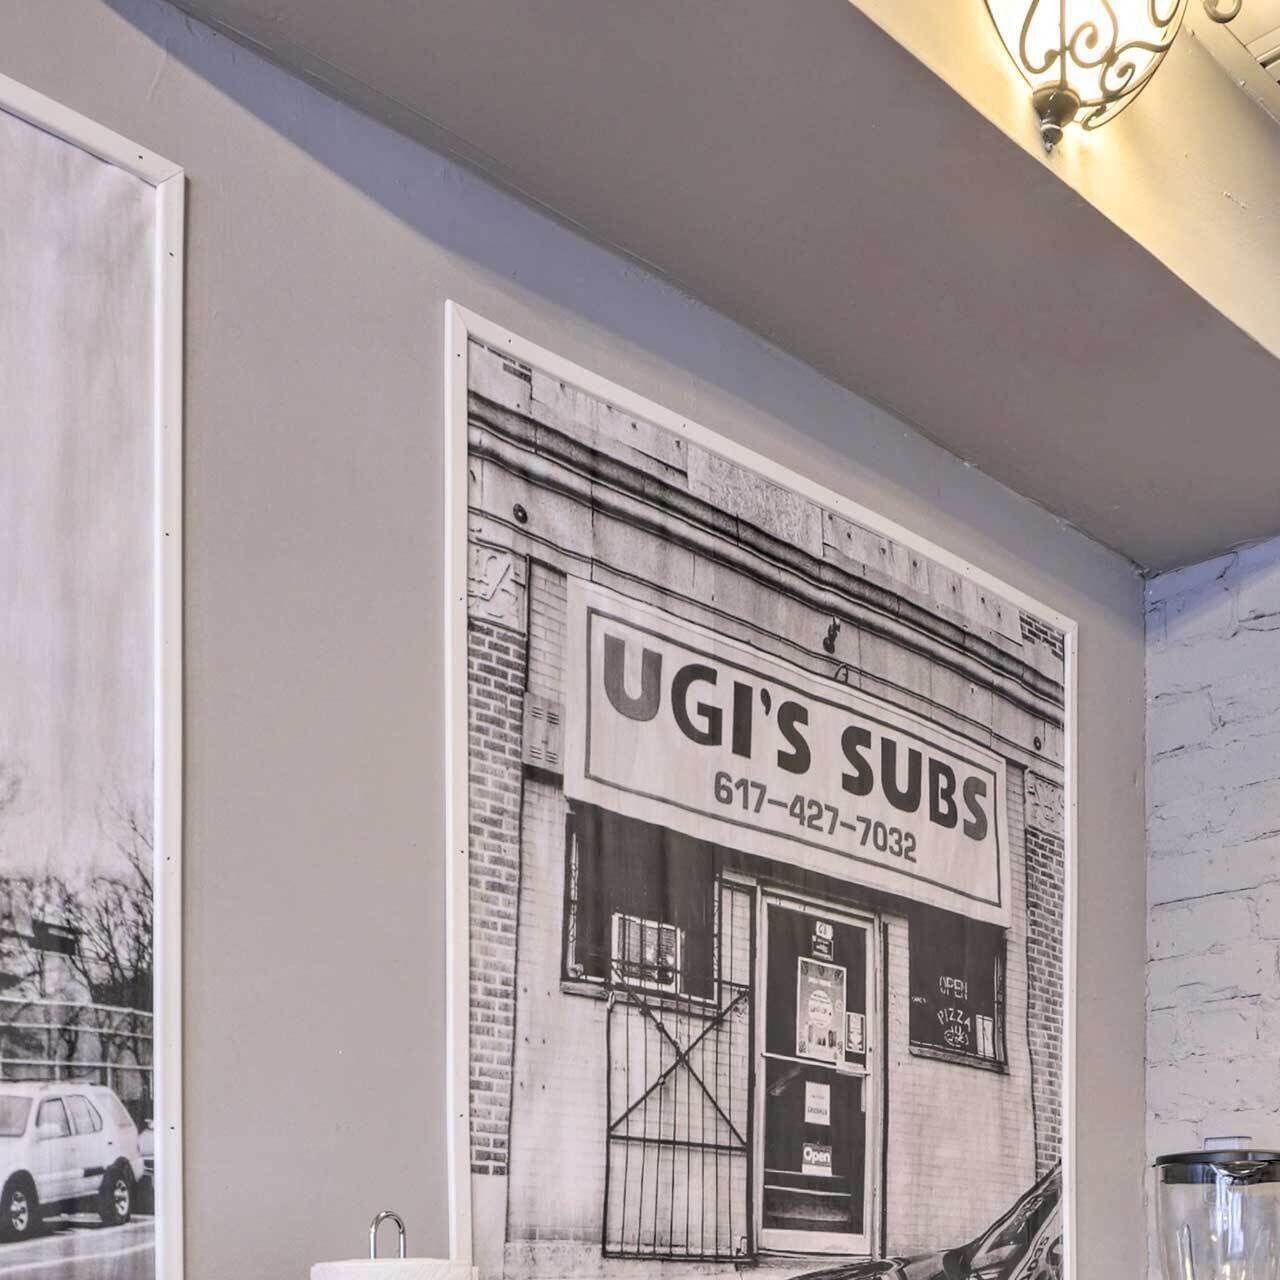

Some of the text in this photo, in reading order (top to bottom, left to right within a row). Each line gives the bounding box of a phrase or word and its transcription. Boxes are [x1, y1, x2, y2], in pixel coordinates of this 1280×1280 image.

[603, 633, 988, 842] UGI'S SUBS
[714, 771, 917, 864] 617-427-7032
[803, 1147, 831, 1164] Open
